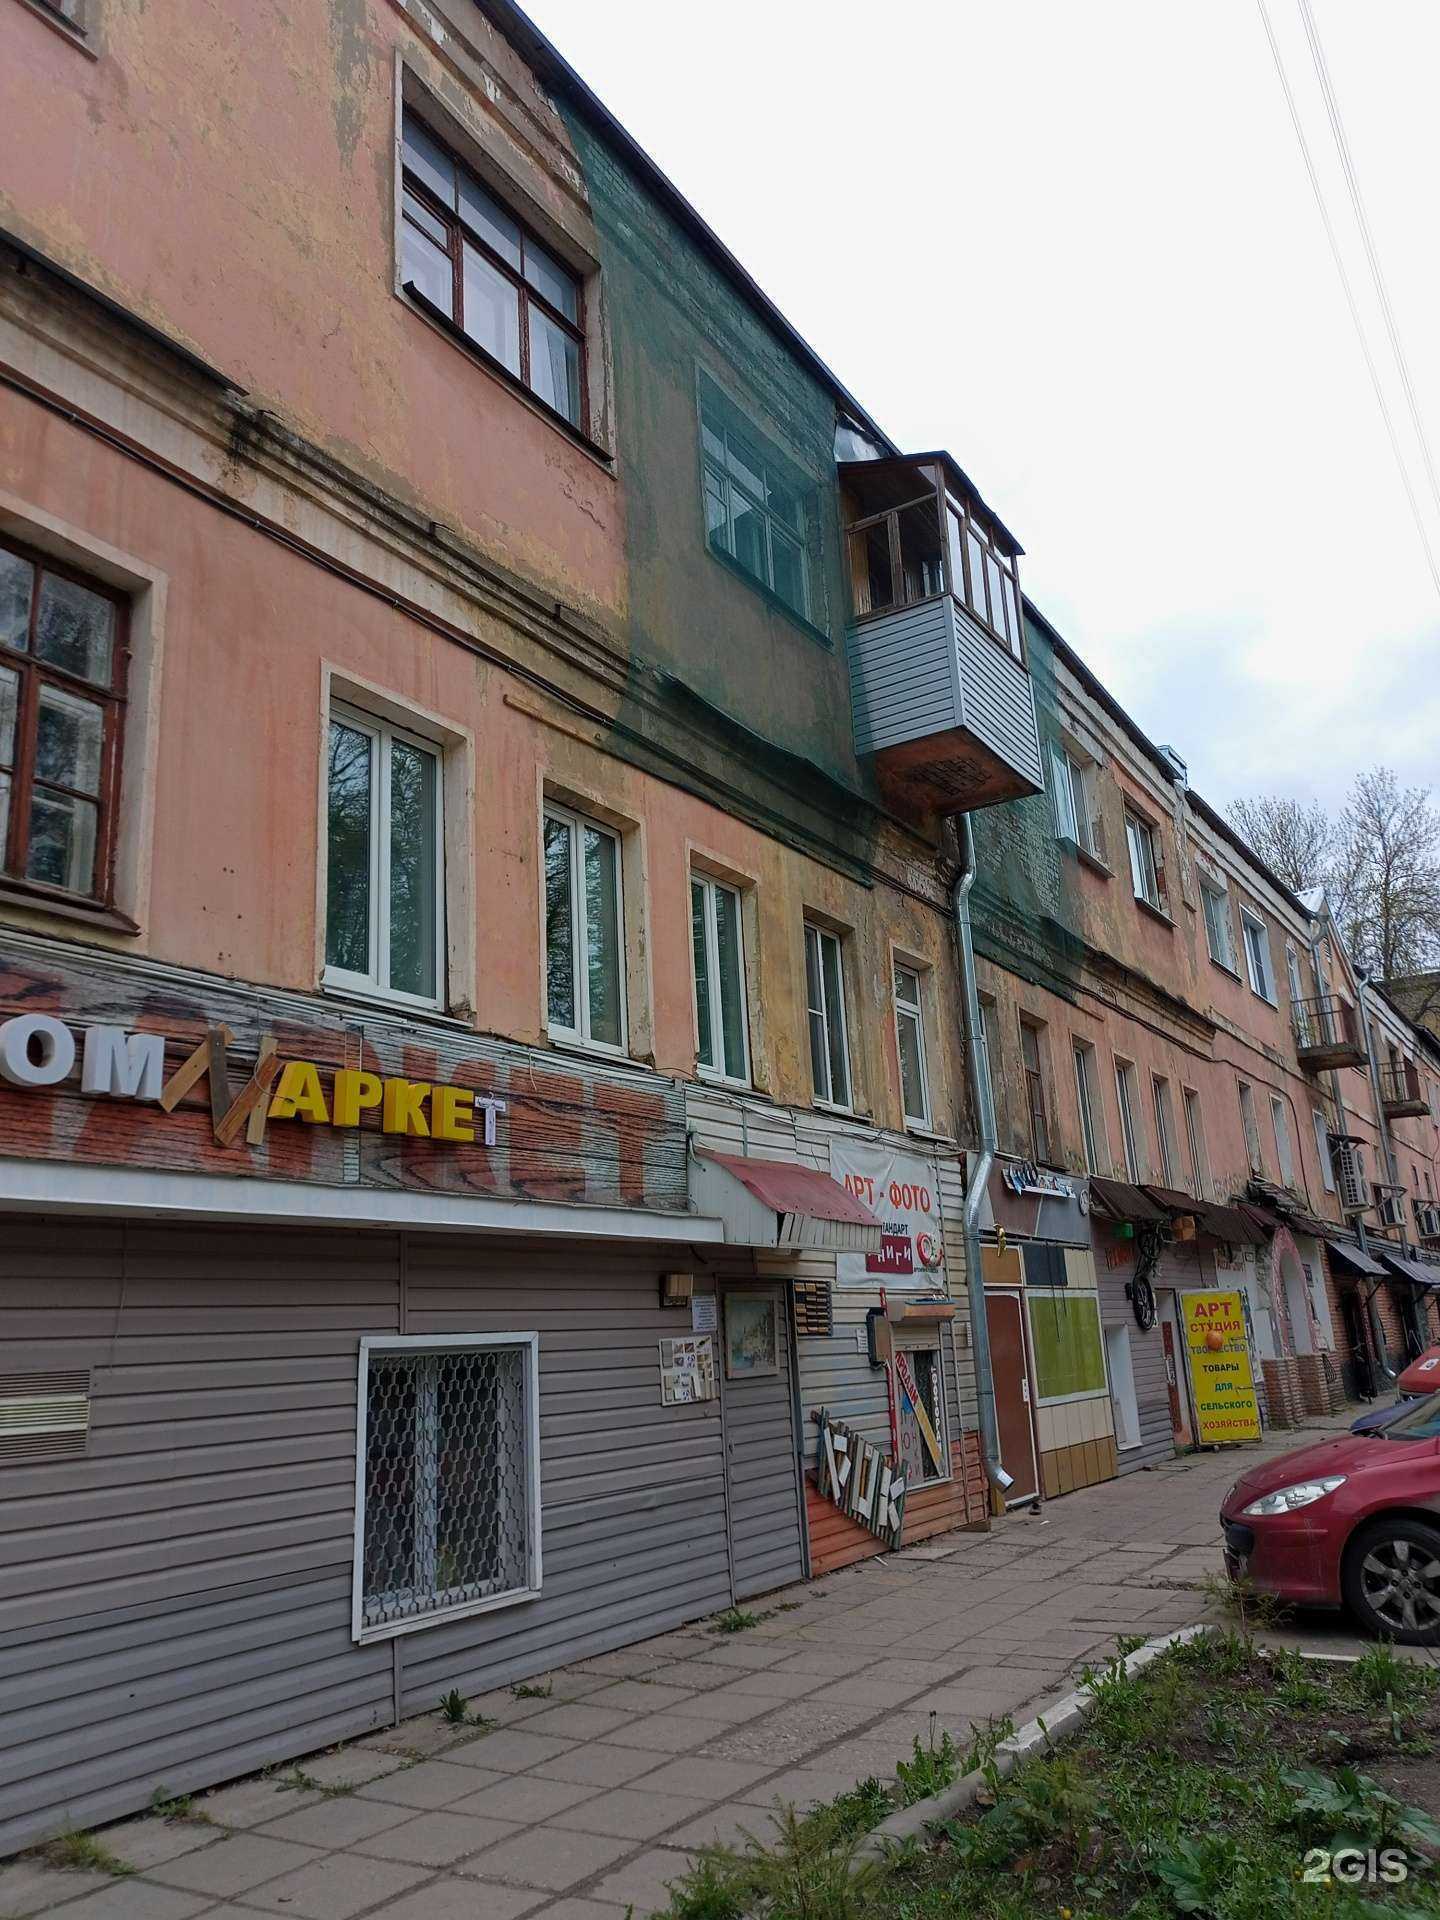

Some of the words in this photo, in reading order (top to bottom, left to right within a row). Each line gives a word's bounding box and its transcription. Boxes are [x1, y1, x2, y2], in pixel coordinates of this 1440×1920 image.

[845, 1174, 875, 1205] АРТ
[889, 1181, 931, 1213] ФОТО
[868, 1245, 911, 1266] НИГИ
[1195, 1302, 1232, 1318] АРТ
[1190, 1320, 1241, 1333] СТУДИЯ
[1202, 1363, 1240, 1374] ТОВАРЫ
[1214, 1382, 1233, 1393] ДЛЯ
[1200, 1400, 1253, 1411] СЕЛЬСКОГО
[1203, 1418, 1256, 1430] ХОЗЯЙСТВА
